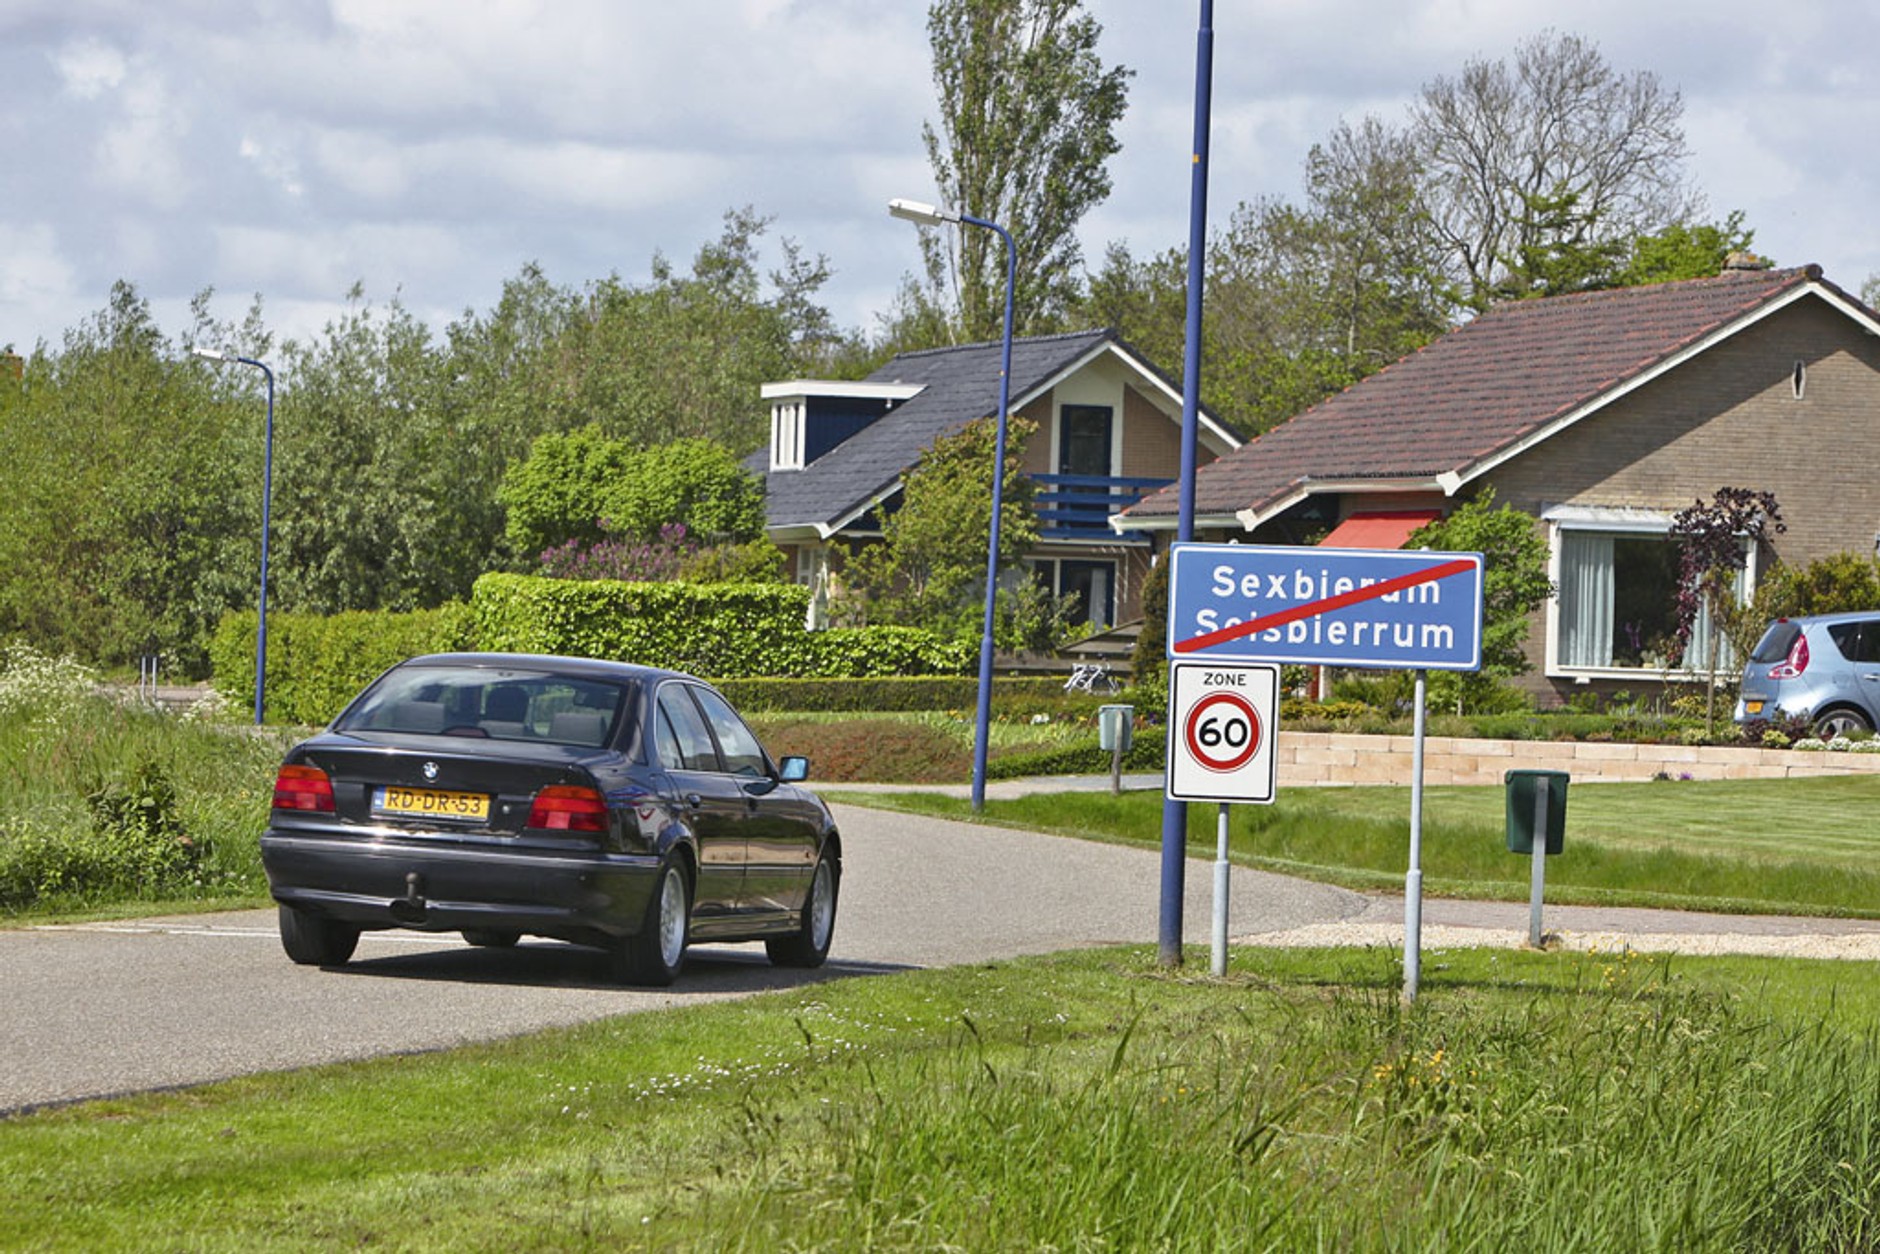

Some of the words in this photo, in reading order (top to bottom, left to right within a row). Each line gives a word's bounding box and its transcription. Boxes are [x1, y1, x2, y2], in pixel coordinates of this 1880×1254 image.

[1203, 672, 1247, 686] ZONE
[1199, 717, 1248, 748] 60
[387, 789, 482, 814] RD-DR-53
